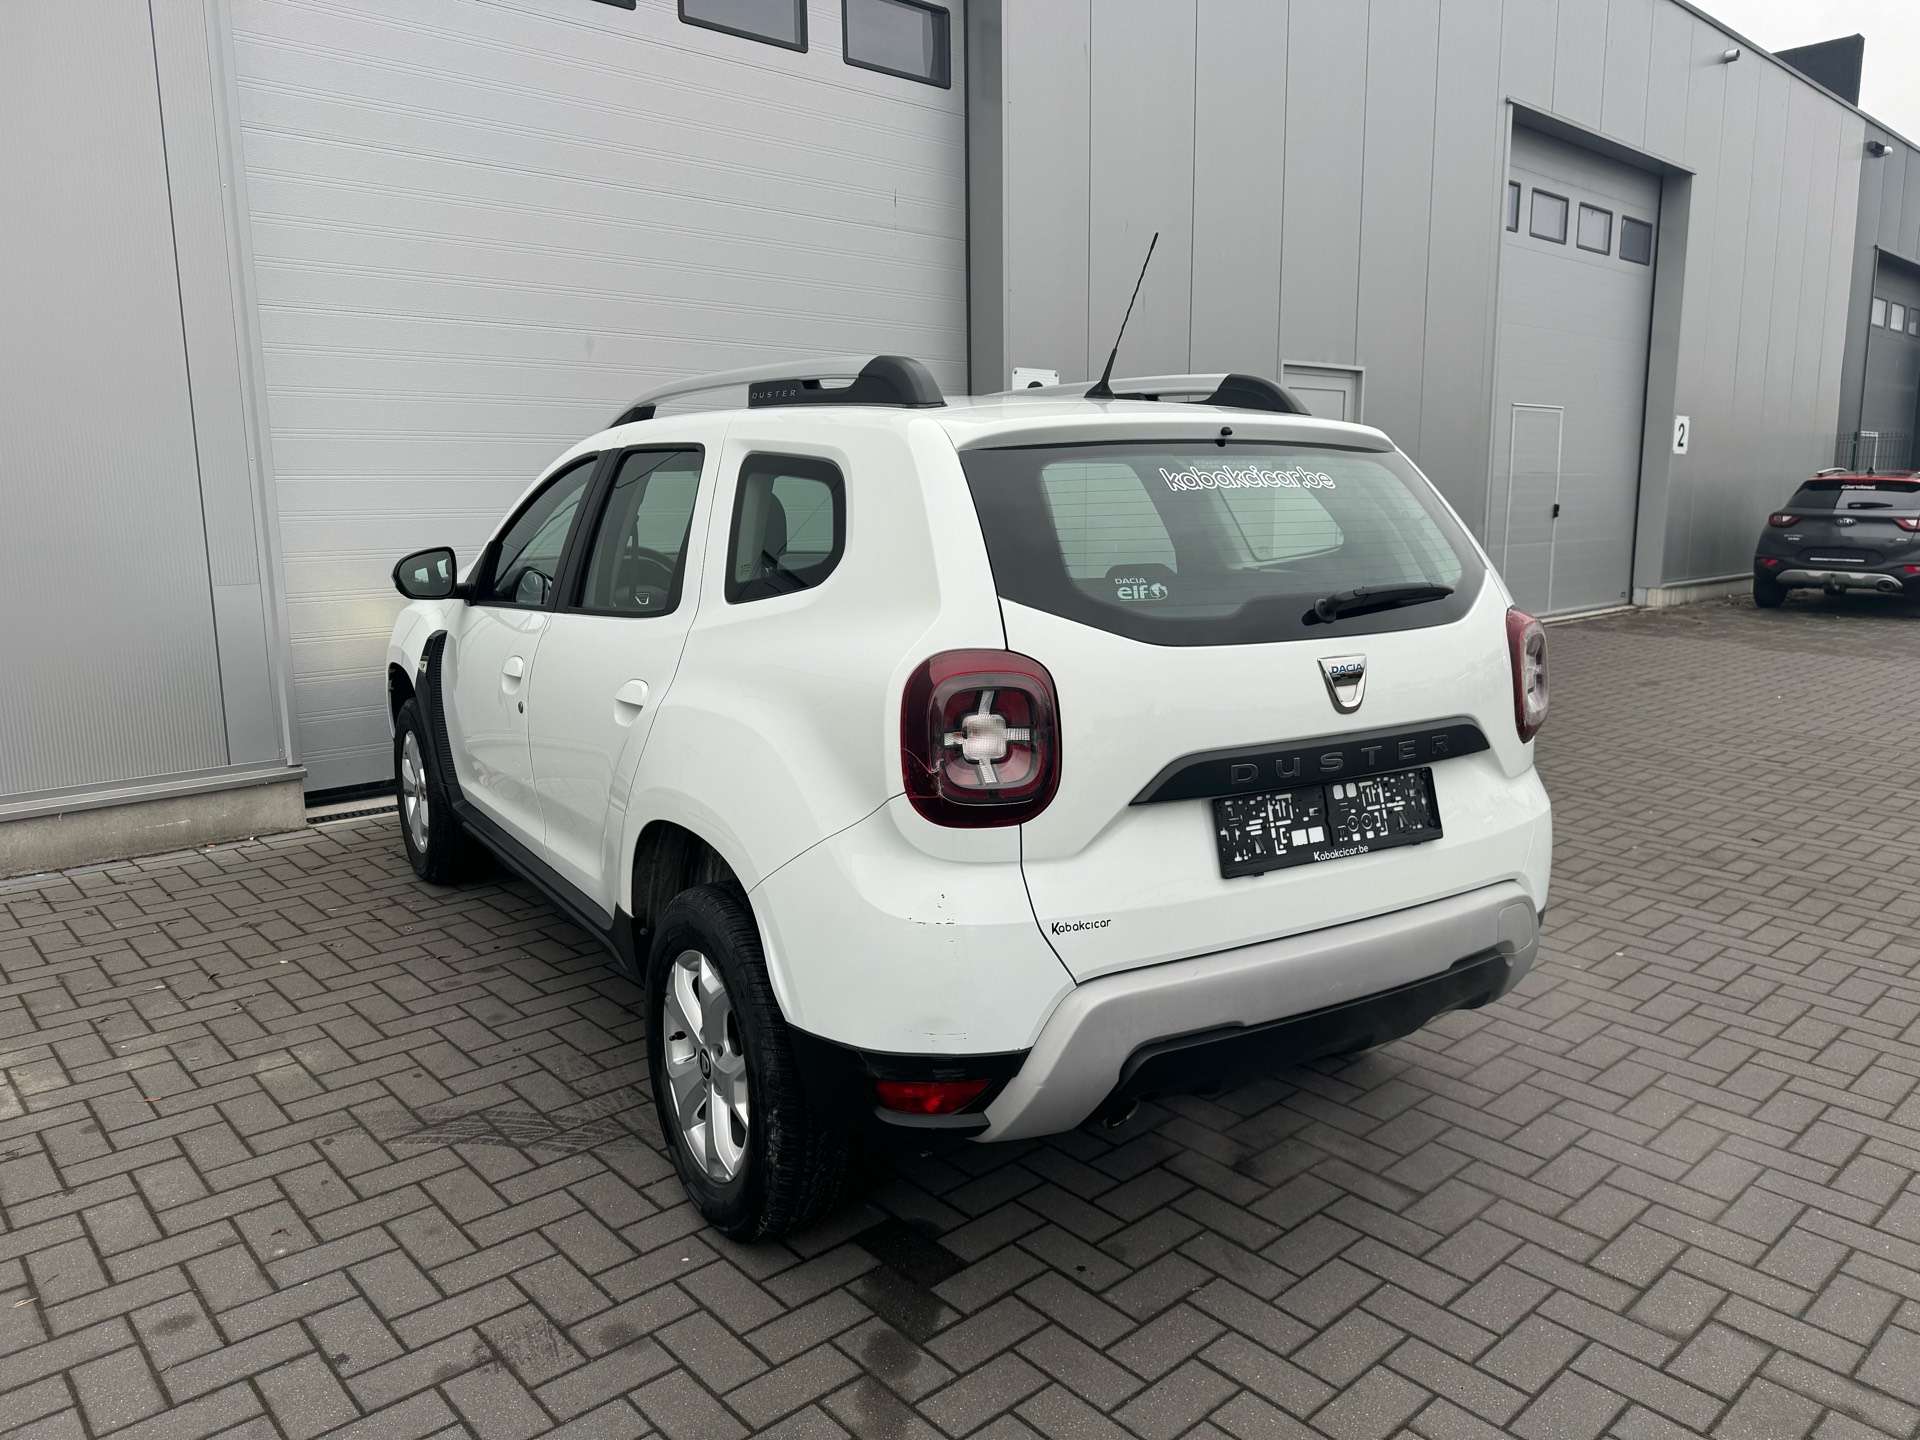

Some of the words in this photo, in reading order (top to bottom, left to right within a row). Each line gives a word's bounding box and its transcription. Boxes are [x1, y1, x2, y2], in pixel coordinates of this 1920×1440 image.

[751, 389, 797, 399] DUSTER
[1677, 422, 1685, 447] 2
[1159, 465, 1336, 492] kabakcicar.be
[1114, 577, 1147, 585] DACIA
[1117, 584, 1149, 600] elf
[1331, 663, 1363, 674] DACIA
[1230, 734, 1450, 785] DUSTER
[1313, 844, 1369, 862] Kabakcicar.be
